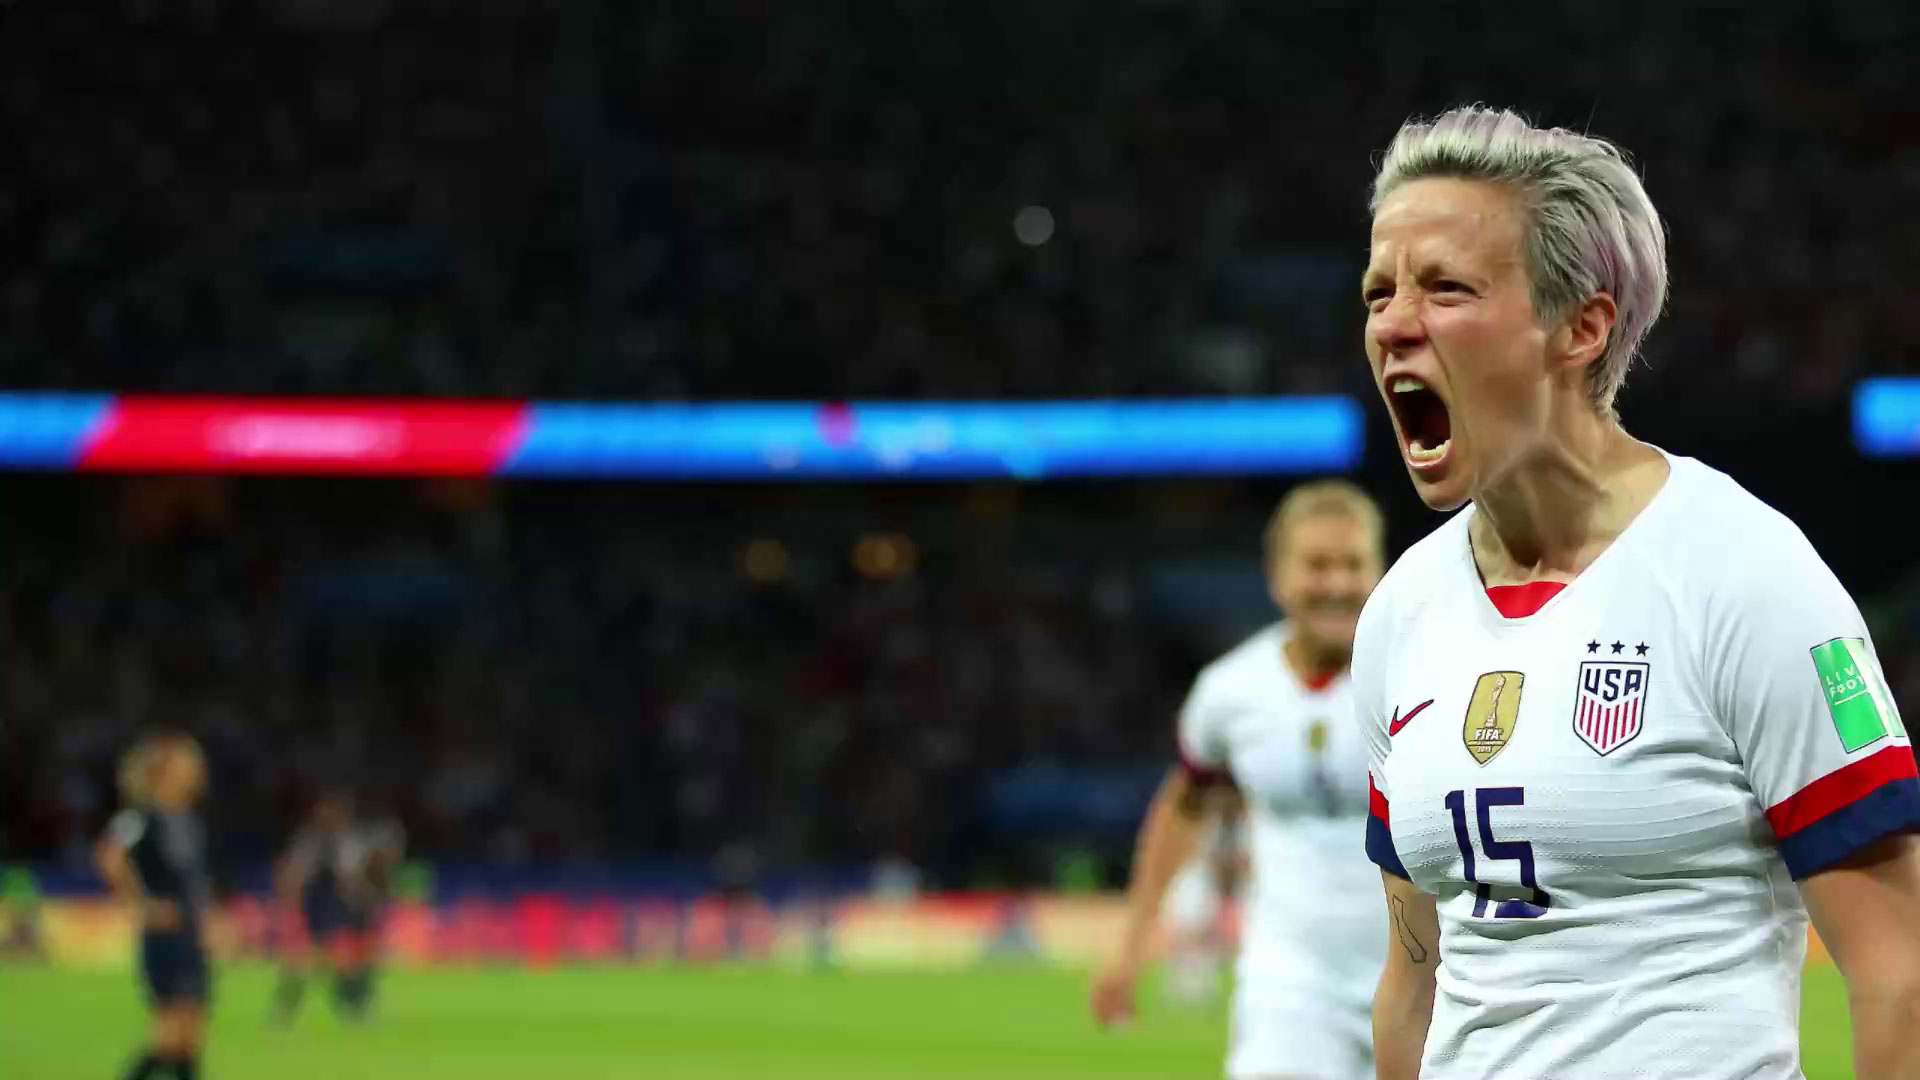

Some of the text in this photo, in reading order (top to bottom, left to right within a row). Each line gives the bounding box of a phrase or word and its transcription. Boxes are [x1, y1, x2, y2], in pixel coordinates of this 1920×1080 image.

[1583, 668, 1642, 702] USA
[1474, 728, 1500, 741] FIFA
[1445, 787, 1552, 918] 15
